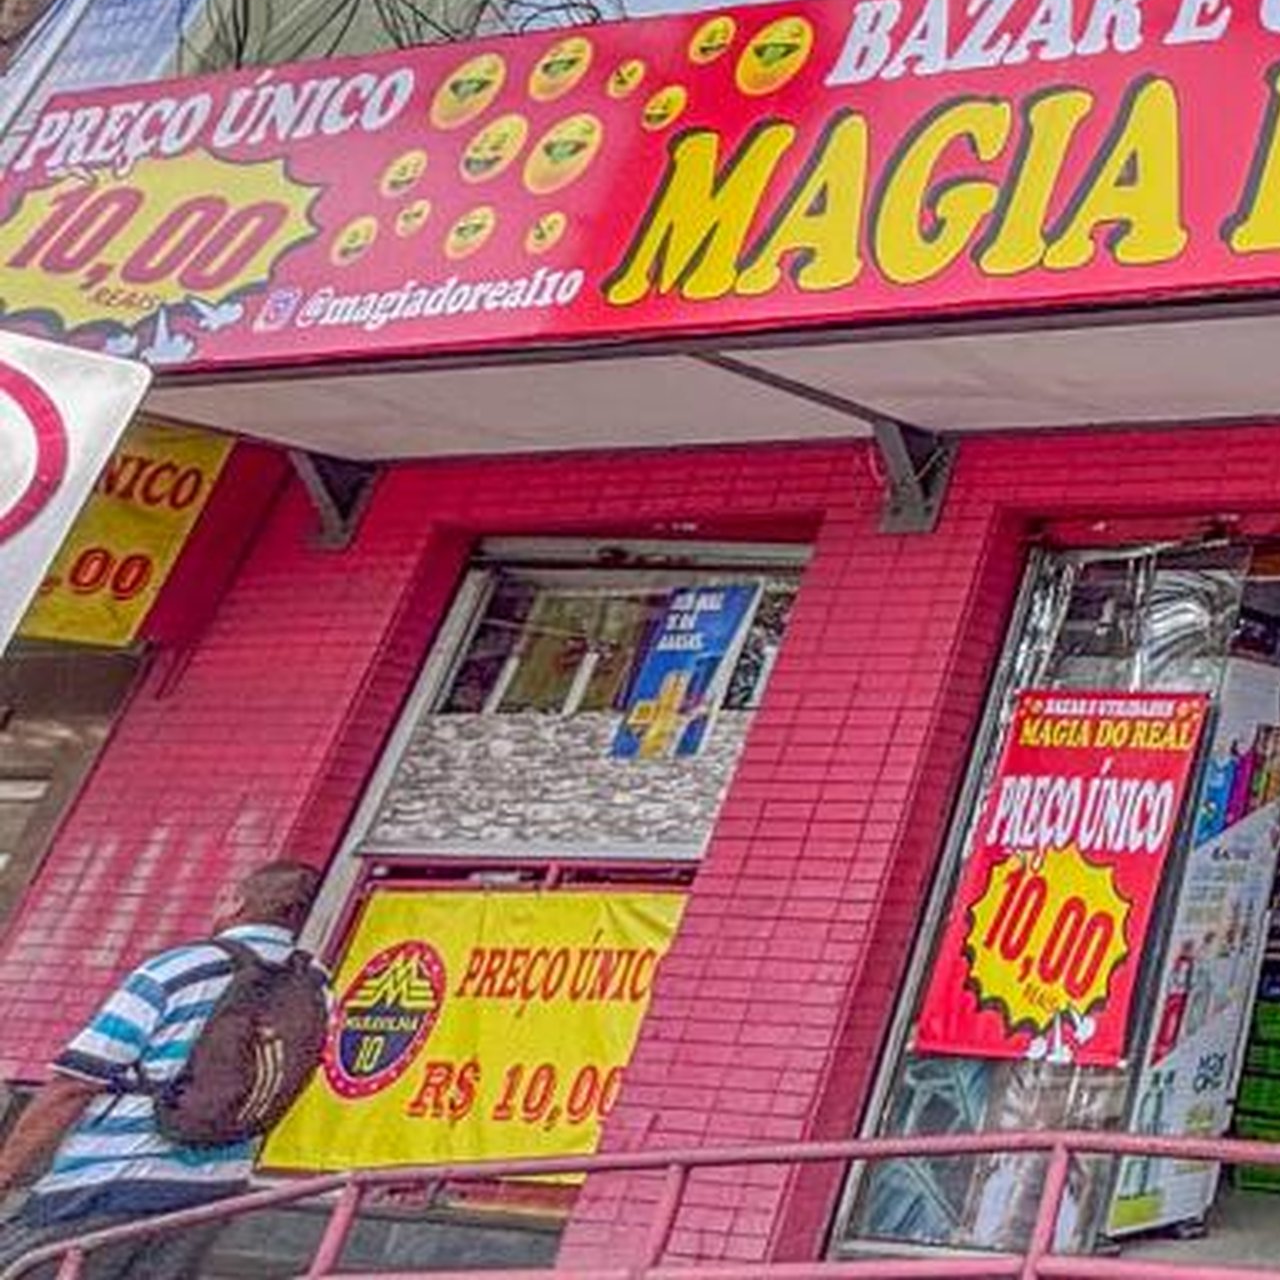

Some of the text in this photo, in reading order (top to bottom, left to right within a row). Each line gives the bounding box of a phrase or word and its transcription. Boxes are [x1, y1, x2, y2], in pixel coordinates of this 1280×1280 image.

[14, 68, 415, 174] PREÇO ÚNICO
[5, 185, 290, 287] 10,00
[605, 73, 1188, 307] MAGIA
[296, 267, 585, 331] @magiadoreal10
[97, 455, 203, 510] NICO
[1019, 718, 1192, 751] MAGIA DO REAL
[986, 759, 1174, 868] PREÇO ÚNICO
[455, 929, 660, 1018] PREÇO ÚNIC
[984, 870, 1115, 999] 10,00
[407, 1057, 481, 1128] R$
